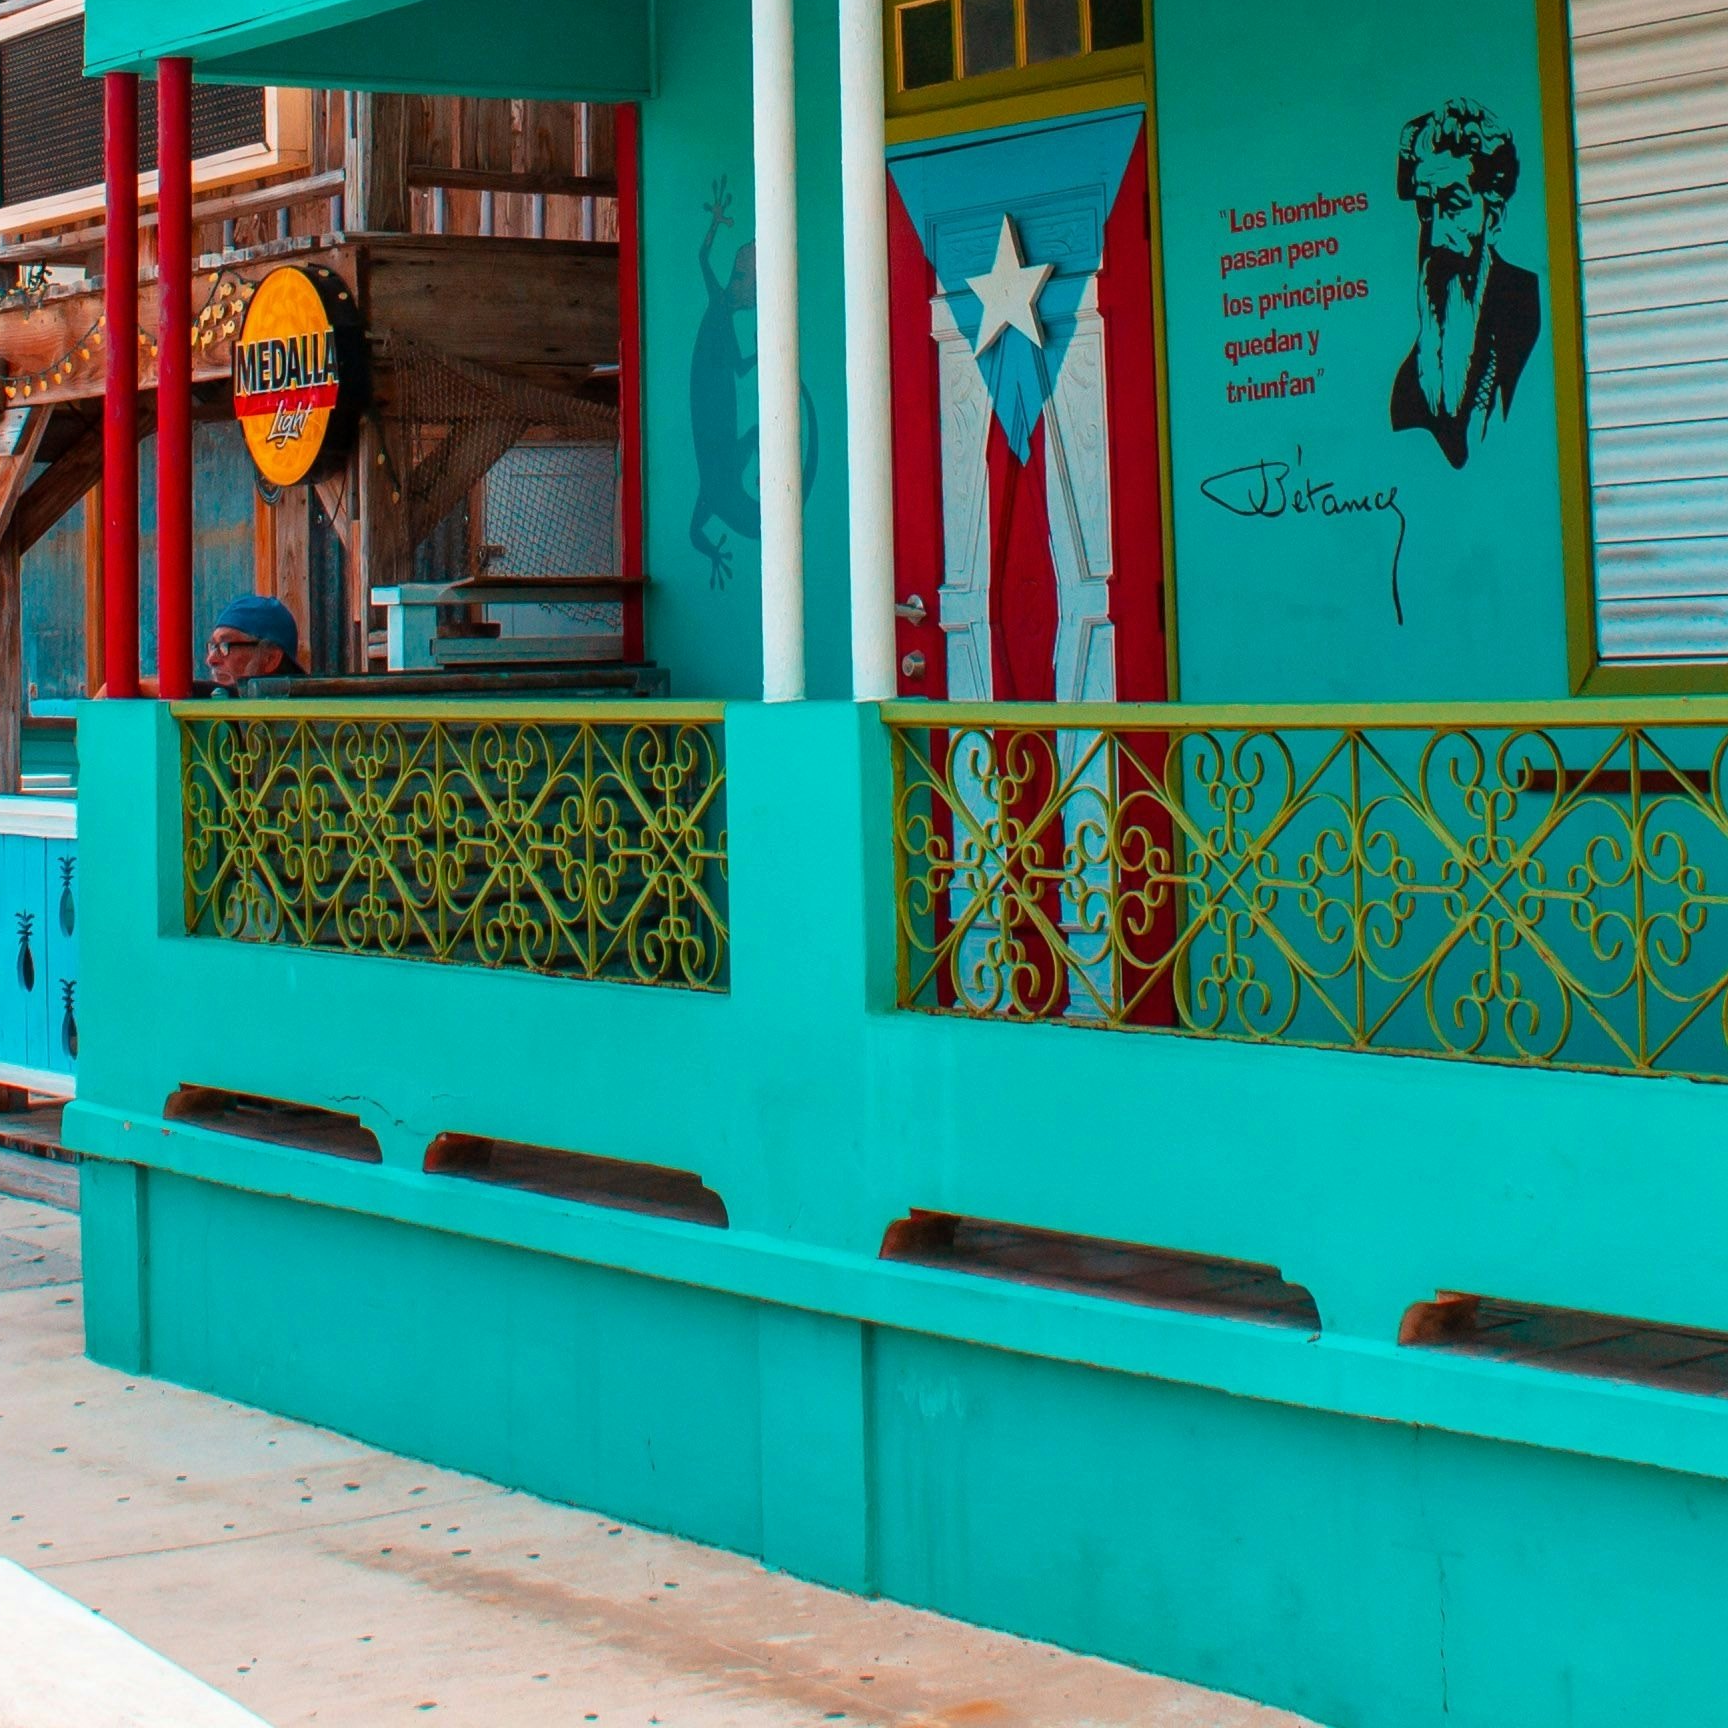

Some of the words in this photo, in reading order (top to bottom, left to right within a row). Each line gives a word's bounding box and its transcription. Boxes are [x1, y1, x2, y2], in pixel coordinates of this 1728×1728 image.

[1272, 192, 1369, 225] hombres
[1220, 245, 1282, 279] pasan
[1288, 236, 1338, 269] pero
[1223, 293, 1253, 317] los
[1259, 276, 1368, 319] principios
[235, 327, 339, 396] MEDALLA
[1224, 328, 1303, 366] quedan
[1308, 329, 1319, 356] y
[266, 399, 313, 448] Light
